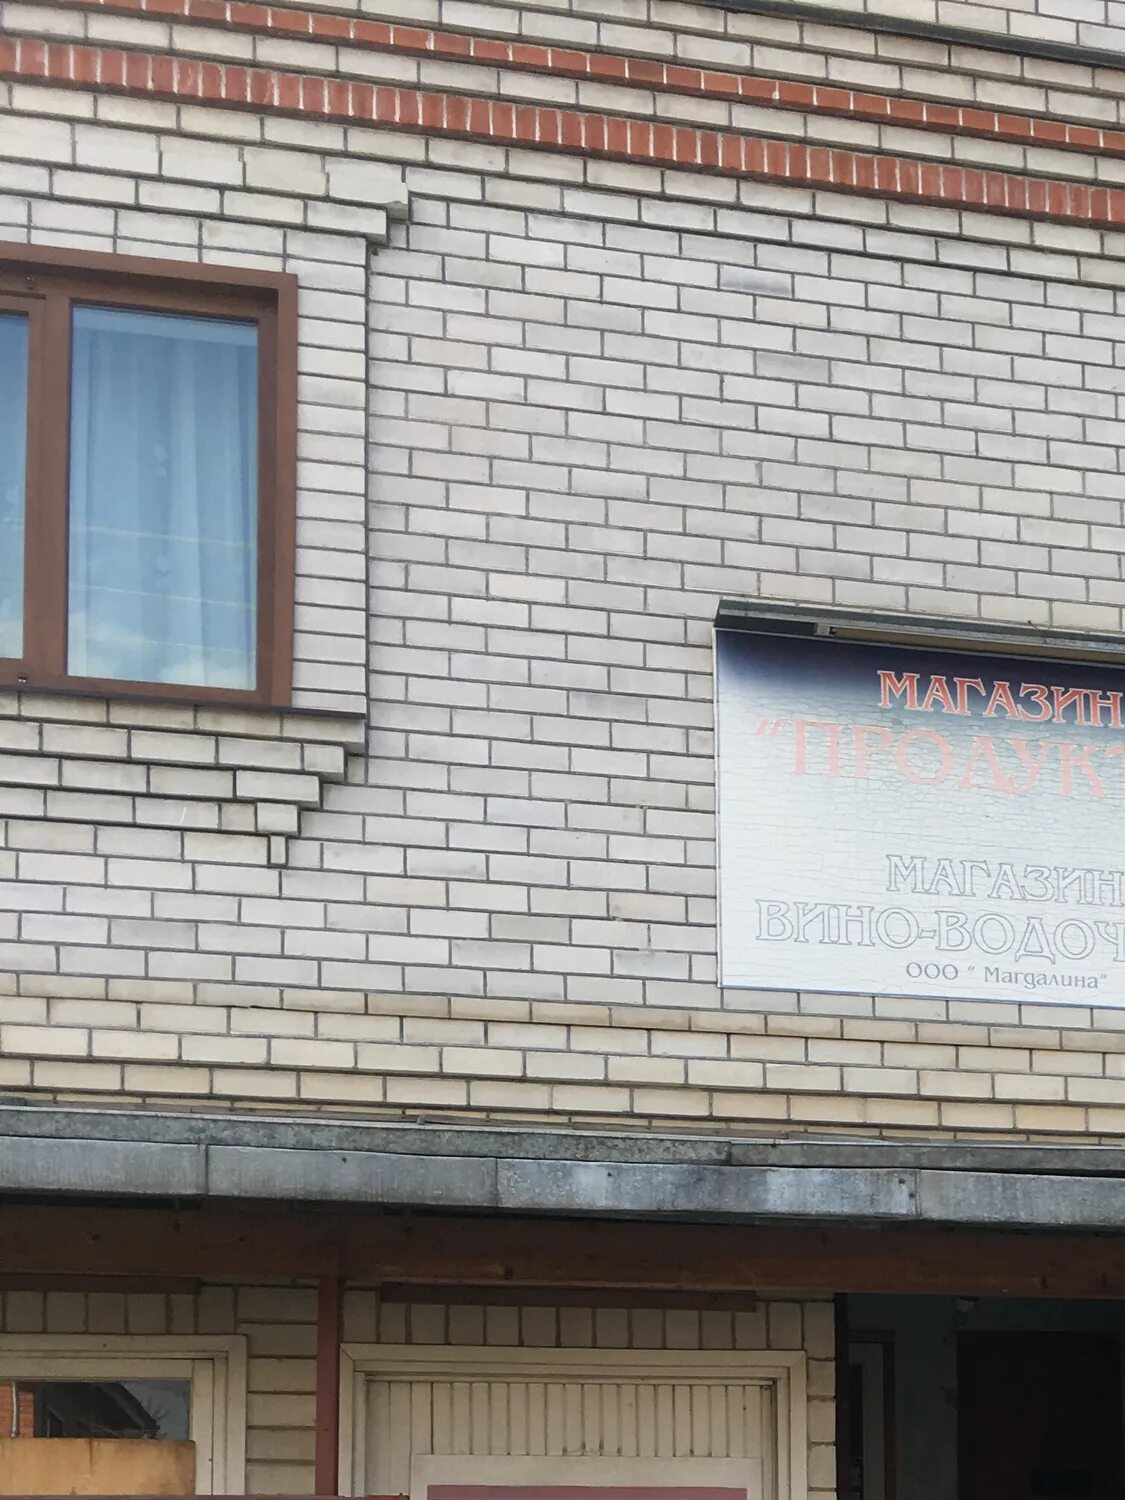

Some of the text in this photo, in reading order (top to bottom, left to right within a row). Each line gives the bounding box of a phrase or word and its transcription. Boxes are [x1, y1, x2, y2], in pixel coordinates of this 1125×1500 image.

[877, 670, 1124, 728] МАГАЗИН
[886, 854, 1125, 908] МАГАЗИН
[906, 962, 959, 981] ООО
